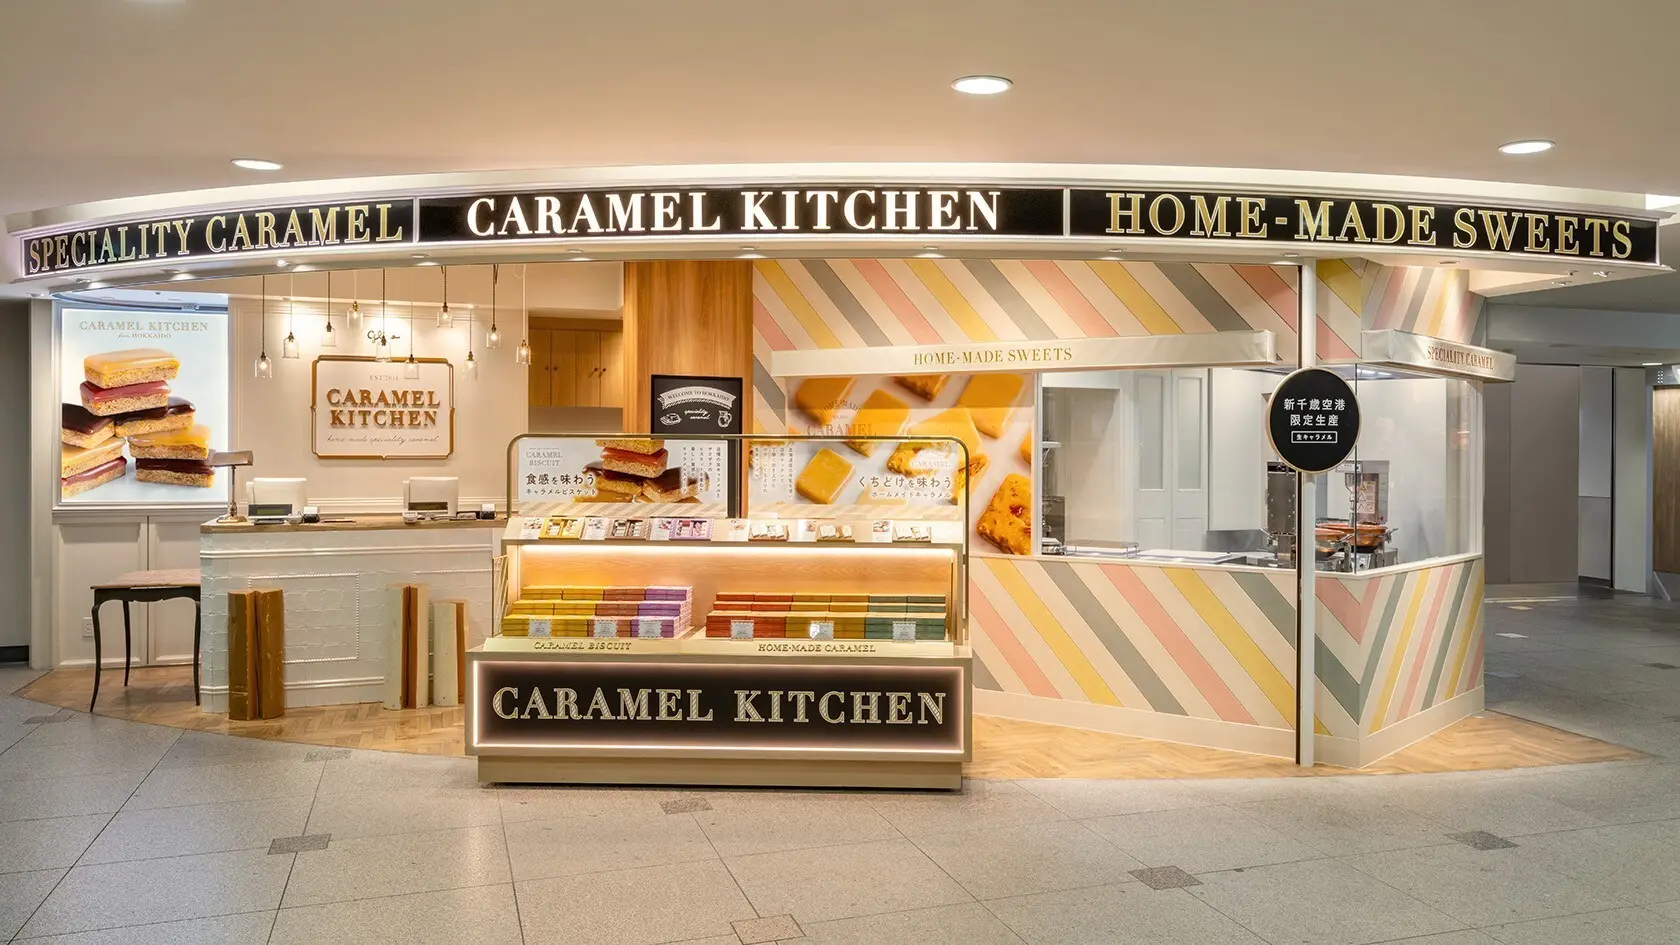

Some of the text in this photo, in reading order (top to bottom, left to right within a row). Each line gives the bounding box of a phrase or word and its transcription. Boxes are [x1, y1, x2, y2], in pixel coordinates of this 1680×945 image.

[467, 190, 1001, 237] CARAMEL KITCHEN
[1105, 193, 1633, 259] HOME-MADE SWEETS
[29, 203, 403, 273] SPECIALITY CARAMEL
[79, 321, 209, 332] CARAMEL KITCHEN
[914, 347, 1073, 365] HOME-MADE SWEETS
[1427, 345, 1494, 370] SPECIALITY CARAMEL
[326, 388, 441, 408] CARAMEL
[668, 390, 693, 400] WELCOME
[1283, 398, 1346, 411] 新千歳空港
[329, 409, 438, 428] KITCHEN
[1290, 414, 1339, 426] 限定生産
[525, 450, 563, 459] CARAMEL
[528, 459, 561, 467] BISCUIT
[525, 473, 595, 486] 食感を味わう
[858, 476, 951, 488] くちどけを味わう
[526, 488, 597, 496] キャラメルビスケット
[871, 491, 951, 499] ホームメイドキャラメル
[534, 641, 632, 650] CARAMEL BISCUIT
[758, 643, 876, 653] HOME-MADE CARAMEL
[491, 686, 947, 725] CARAMEL KITCHEN
